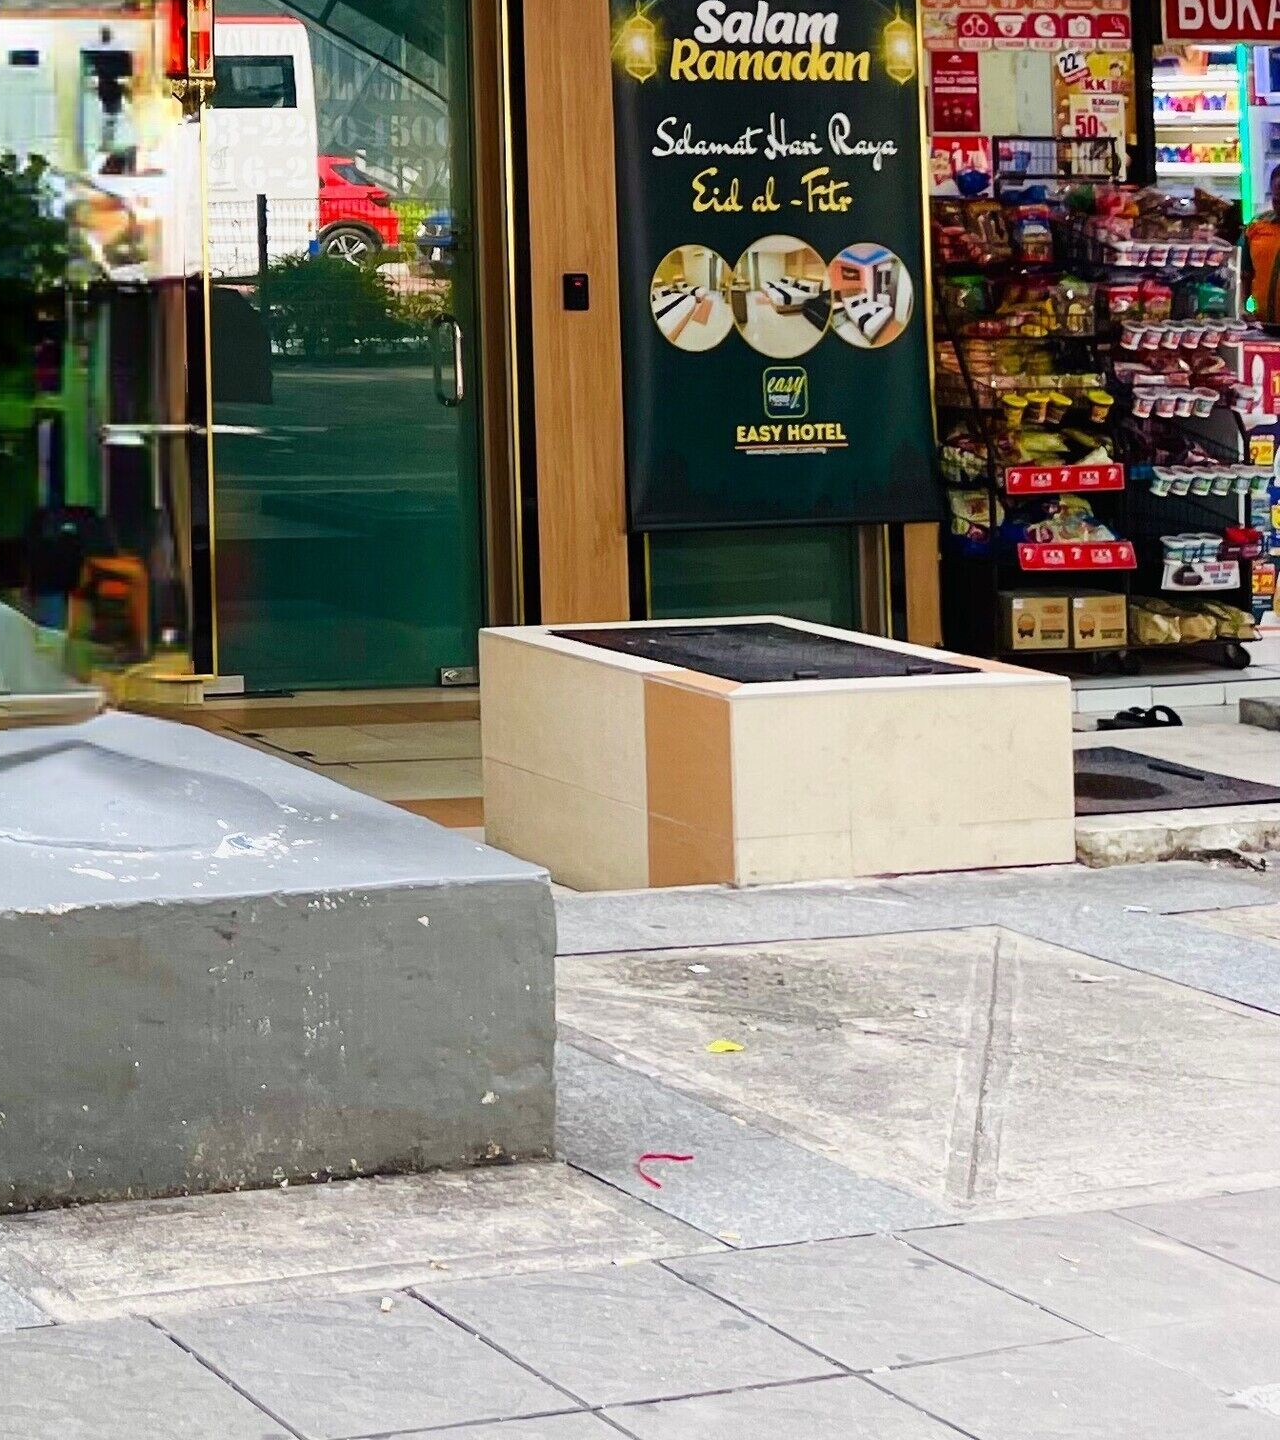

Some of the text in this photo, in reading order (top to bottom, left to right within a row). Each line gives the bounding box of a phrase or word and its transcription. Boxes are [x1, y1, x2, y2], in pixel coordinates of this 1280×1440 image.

[694, 0, 839, 45] Salam
[669, 37, 871, 82] Ramadan
[651, 112, 898, 172] Selamat Hari Raya
[692, 166, 743, 213] Eid
[751, 176, 781, 213] al
[736, 423, 847, 443] EASY HOTEL
